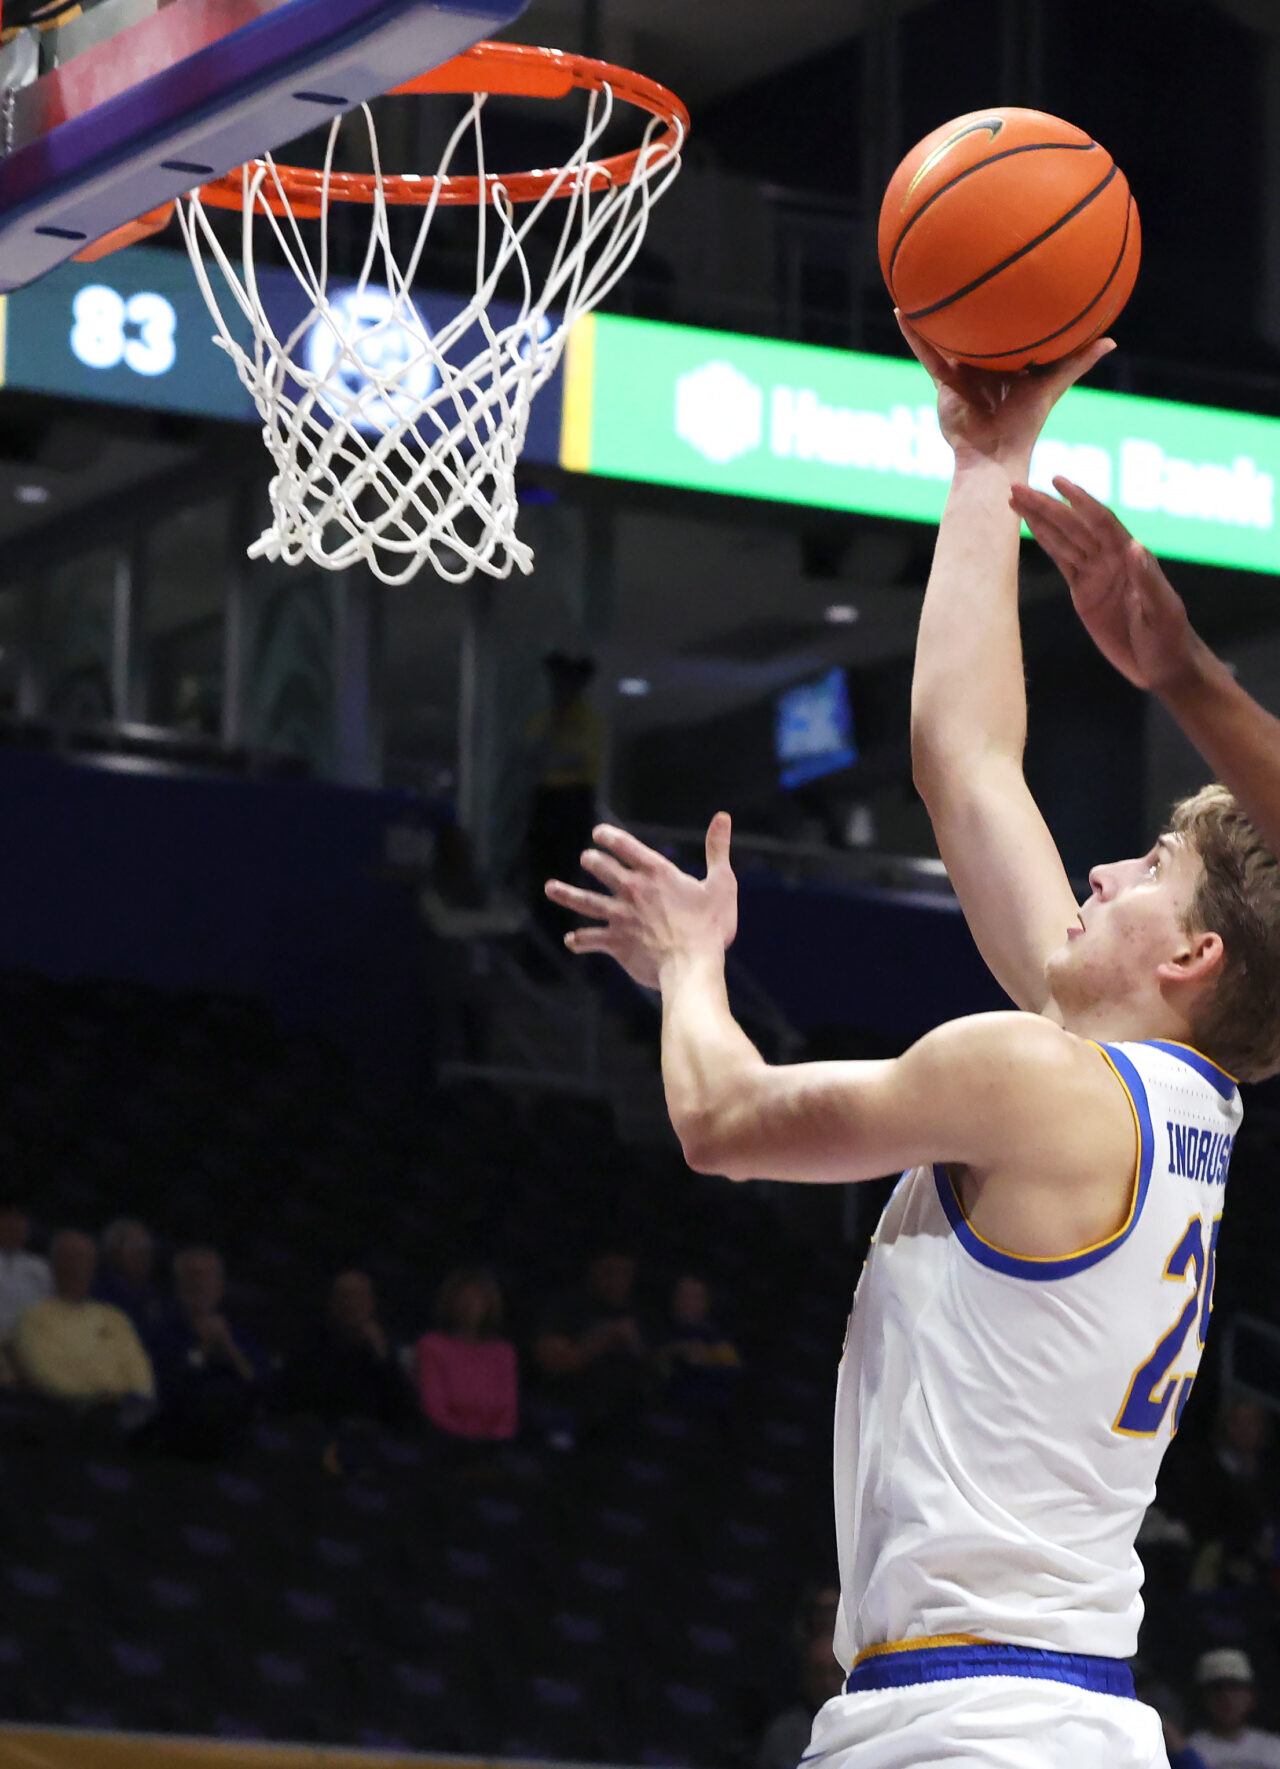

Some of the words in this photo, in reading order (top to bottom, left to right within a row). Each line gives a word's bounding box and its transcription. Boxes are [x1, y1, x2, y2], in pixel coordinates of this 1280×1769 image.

[70, 284, 177, 376] 83
[771, 384, 1111, 503] Huntion
[1119, 437, 1275, 528] Bank
